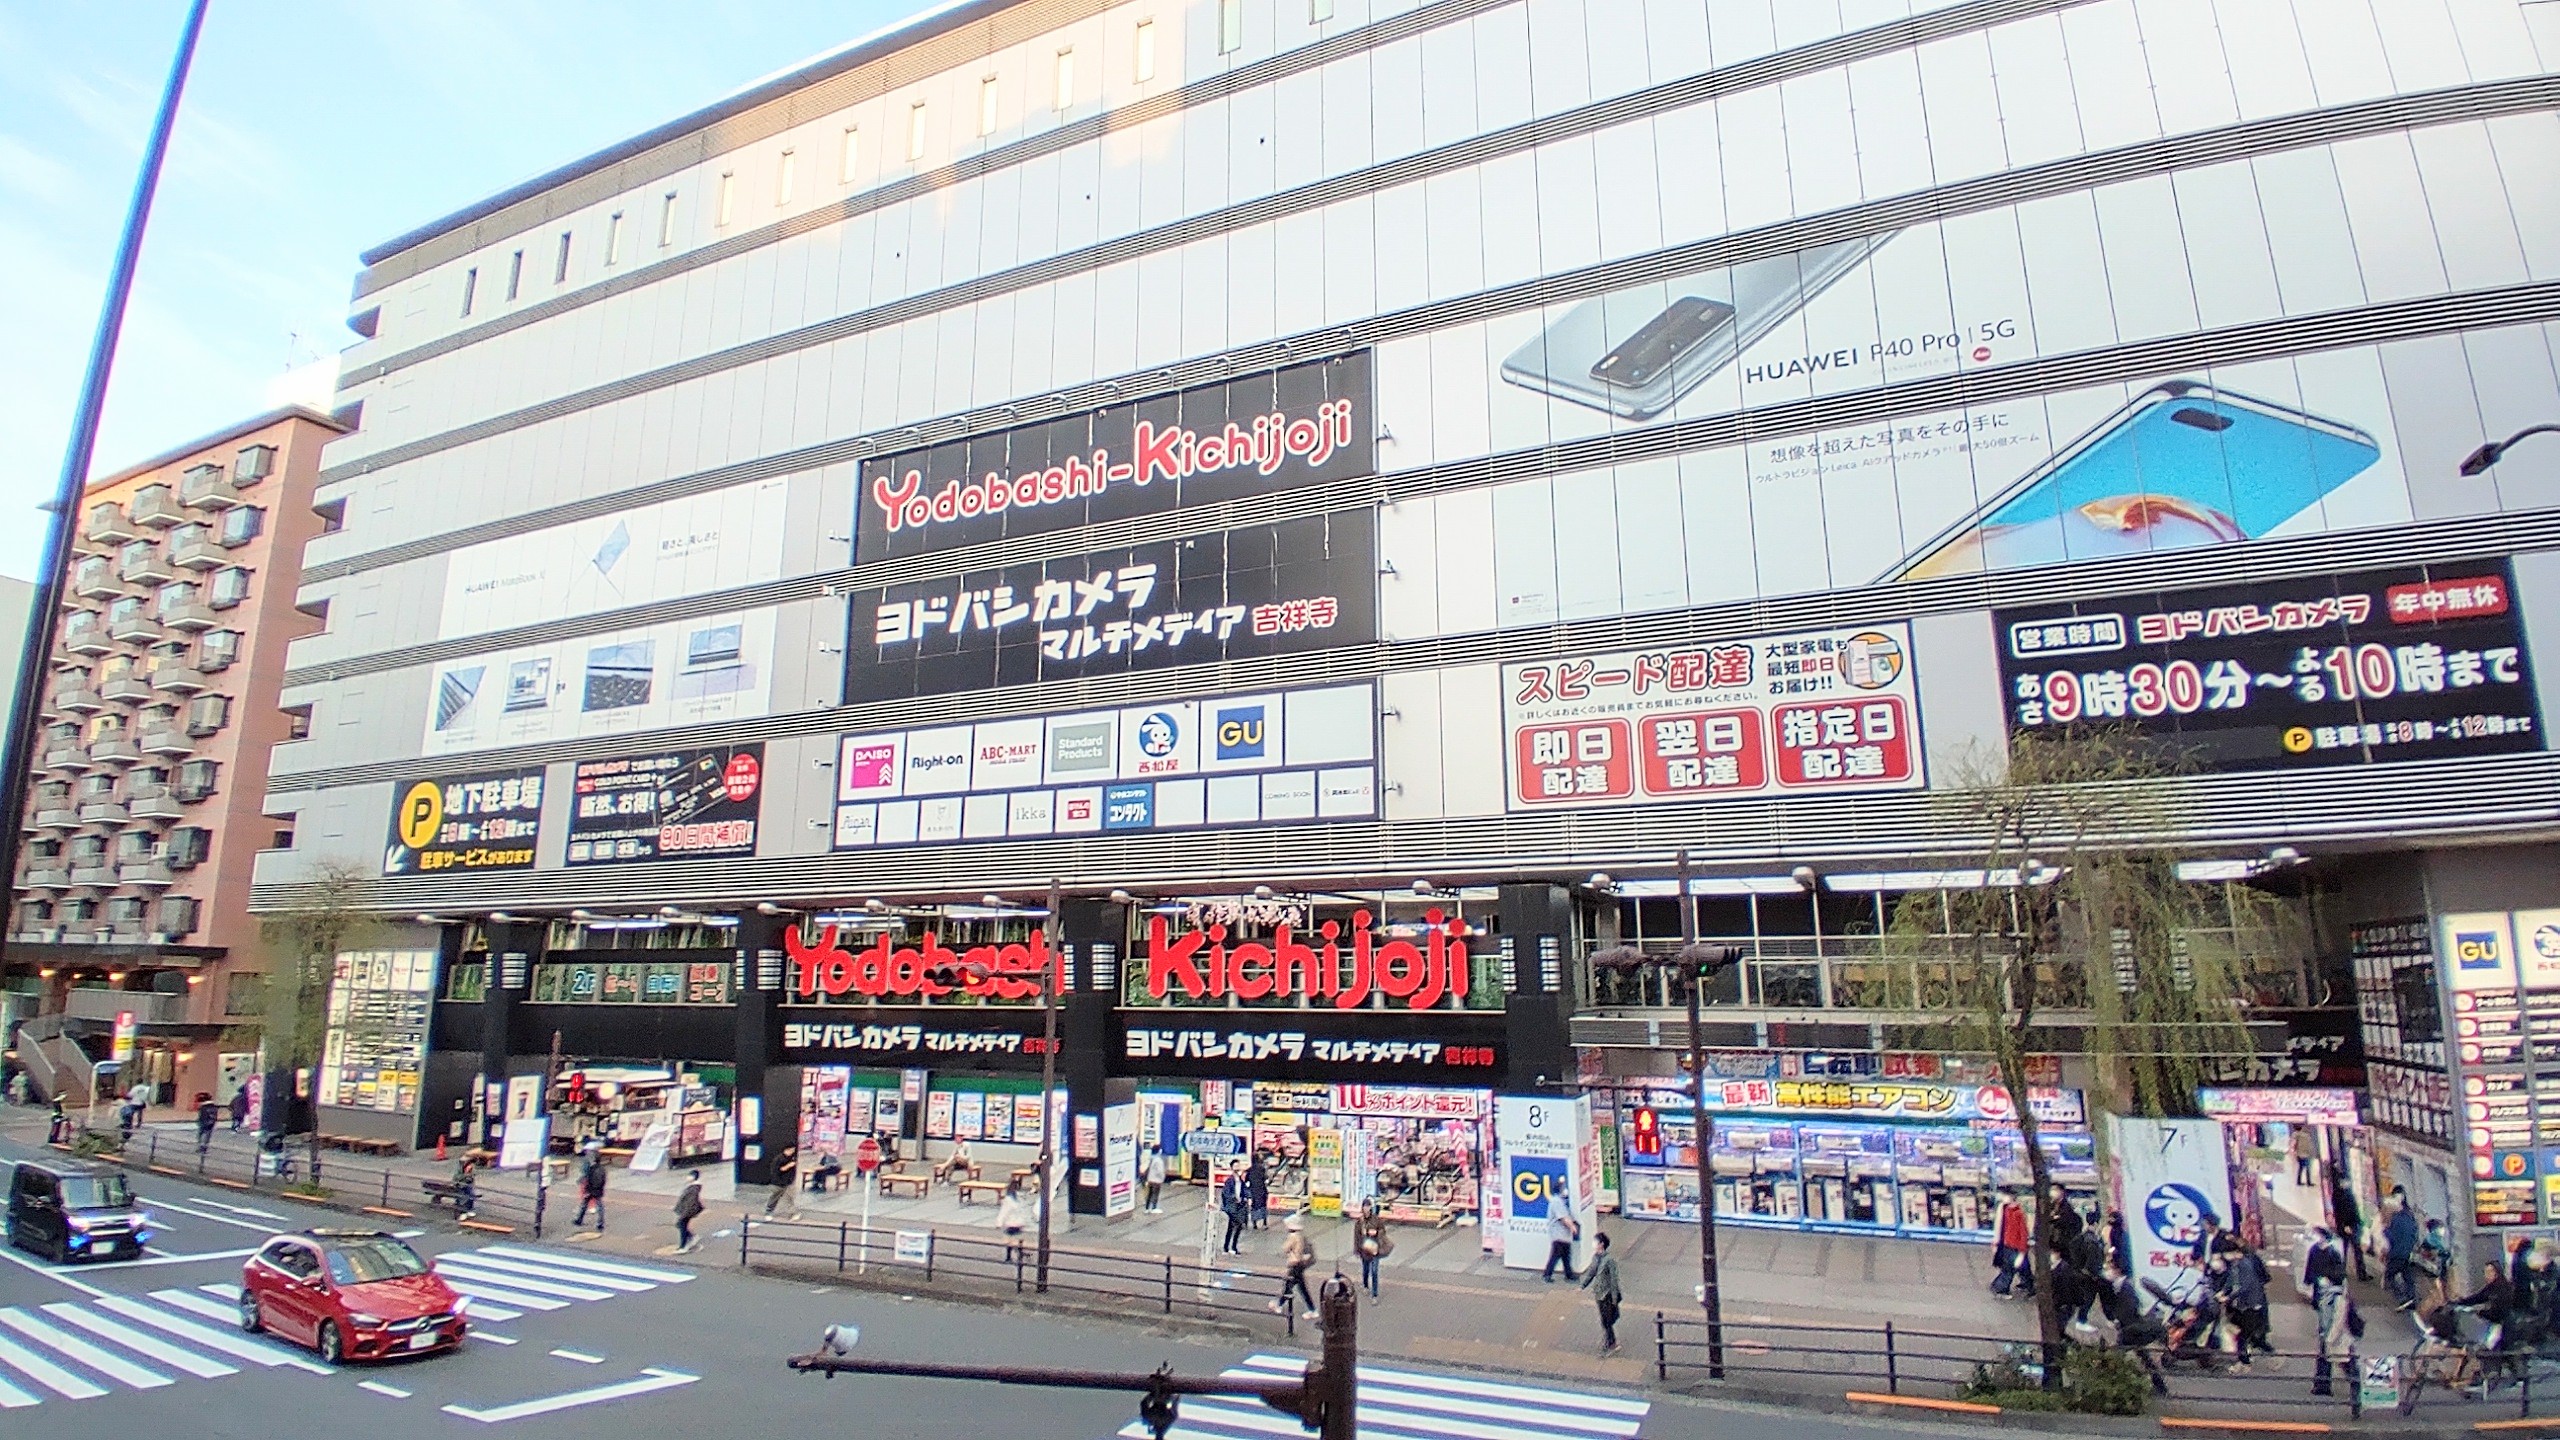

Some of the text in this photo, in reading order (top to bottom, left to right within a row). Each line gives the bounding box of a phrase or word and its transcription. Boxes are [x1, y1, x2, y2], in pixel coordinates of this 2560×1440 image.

[1746, 318, 2015, 384] HUAWEI P40 Pro 5G
[1769, 413, 2009, 463] 想像を超えた写真をその手に
[873, 400, 1352, 532] Yodobashi-Kichijoji
[875, 563, 1158, 645] ヨドバシカメラ
[2018, 582, 2500, 652] 営業時間 ヨドバシカメラ 年中無休
[1039, 596, 1338, 661] マルチメディア 吉祥寺
[1765, 638, 1847, 660] 大型家電も
[1515, 645, 1753, 704] スピード配達
[1767, 657, 1835, 678] 最短即日
[1218, 720, 1264, 747] GU
[1655, 716, 1744, 756] 翌日
[1784, 703, 1896, 748] 指定日
[2315, 724, 2382, 749] 駐車場
[855, 749, 891, 761] DAISO
[980, 744, 1036, 760] ABC-MART
[1058, 736, 1103, 749] Standard
[1058, 747, 1103, 760] Products
[1532, 727, 1613, 765] 即日
[912, 755, 963, 771] Right-on
[1138, 759, 1179, 773] 西松屋
[1667, 756, 1740, 788] 配達
[1802, 746, 1885, 779] 配達
[443, 776, 542, 815] 地下駐車場
[1542, 768, 1609, 796] 配達
[412, 797, 432, 837] P
[1016, 807, 1047, 821] ikka
[1109, 802, 1148, 822] コンタクト
[420, 848, 534, 870] 駐車サービスがあります
[1147, 908, 1469, 1009] Kichijoji
[2460, 941, 2497, 961] GU
[784, 1023, 922, 1050] ヨドバシカメラ
[925, 1031, 1022, 1054] マルチメディア
[1126, 1029, 1307, 1061] ヨドバシカメラ
[1311, 1040, 1441, 1064] マルチメディア
[1722, 1080, 1957, 1113] 最新 高性能エアコン
